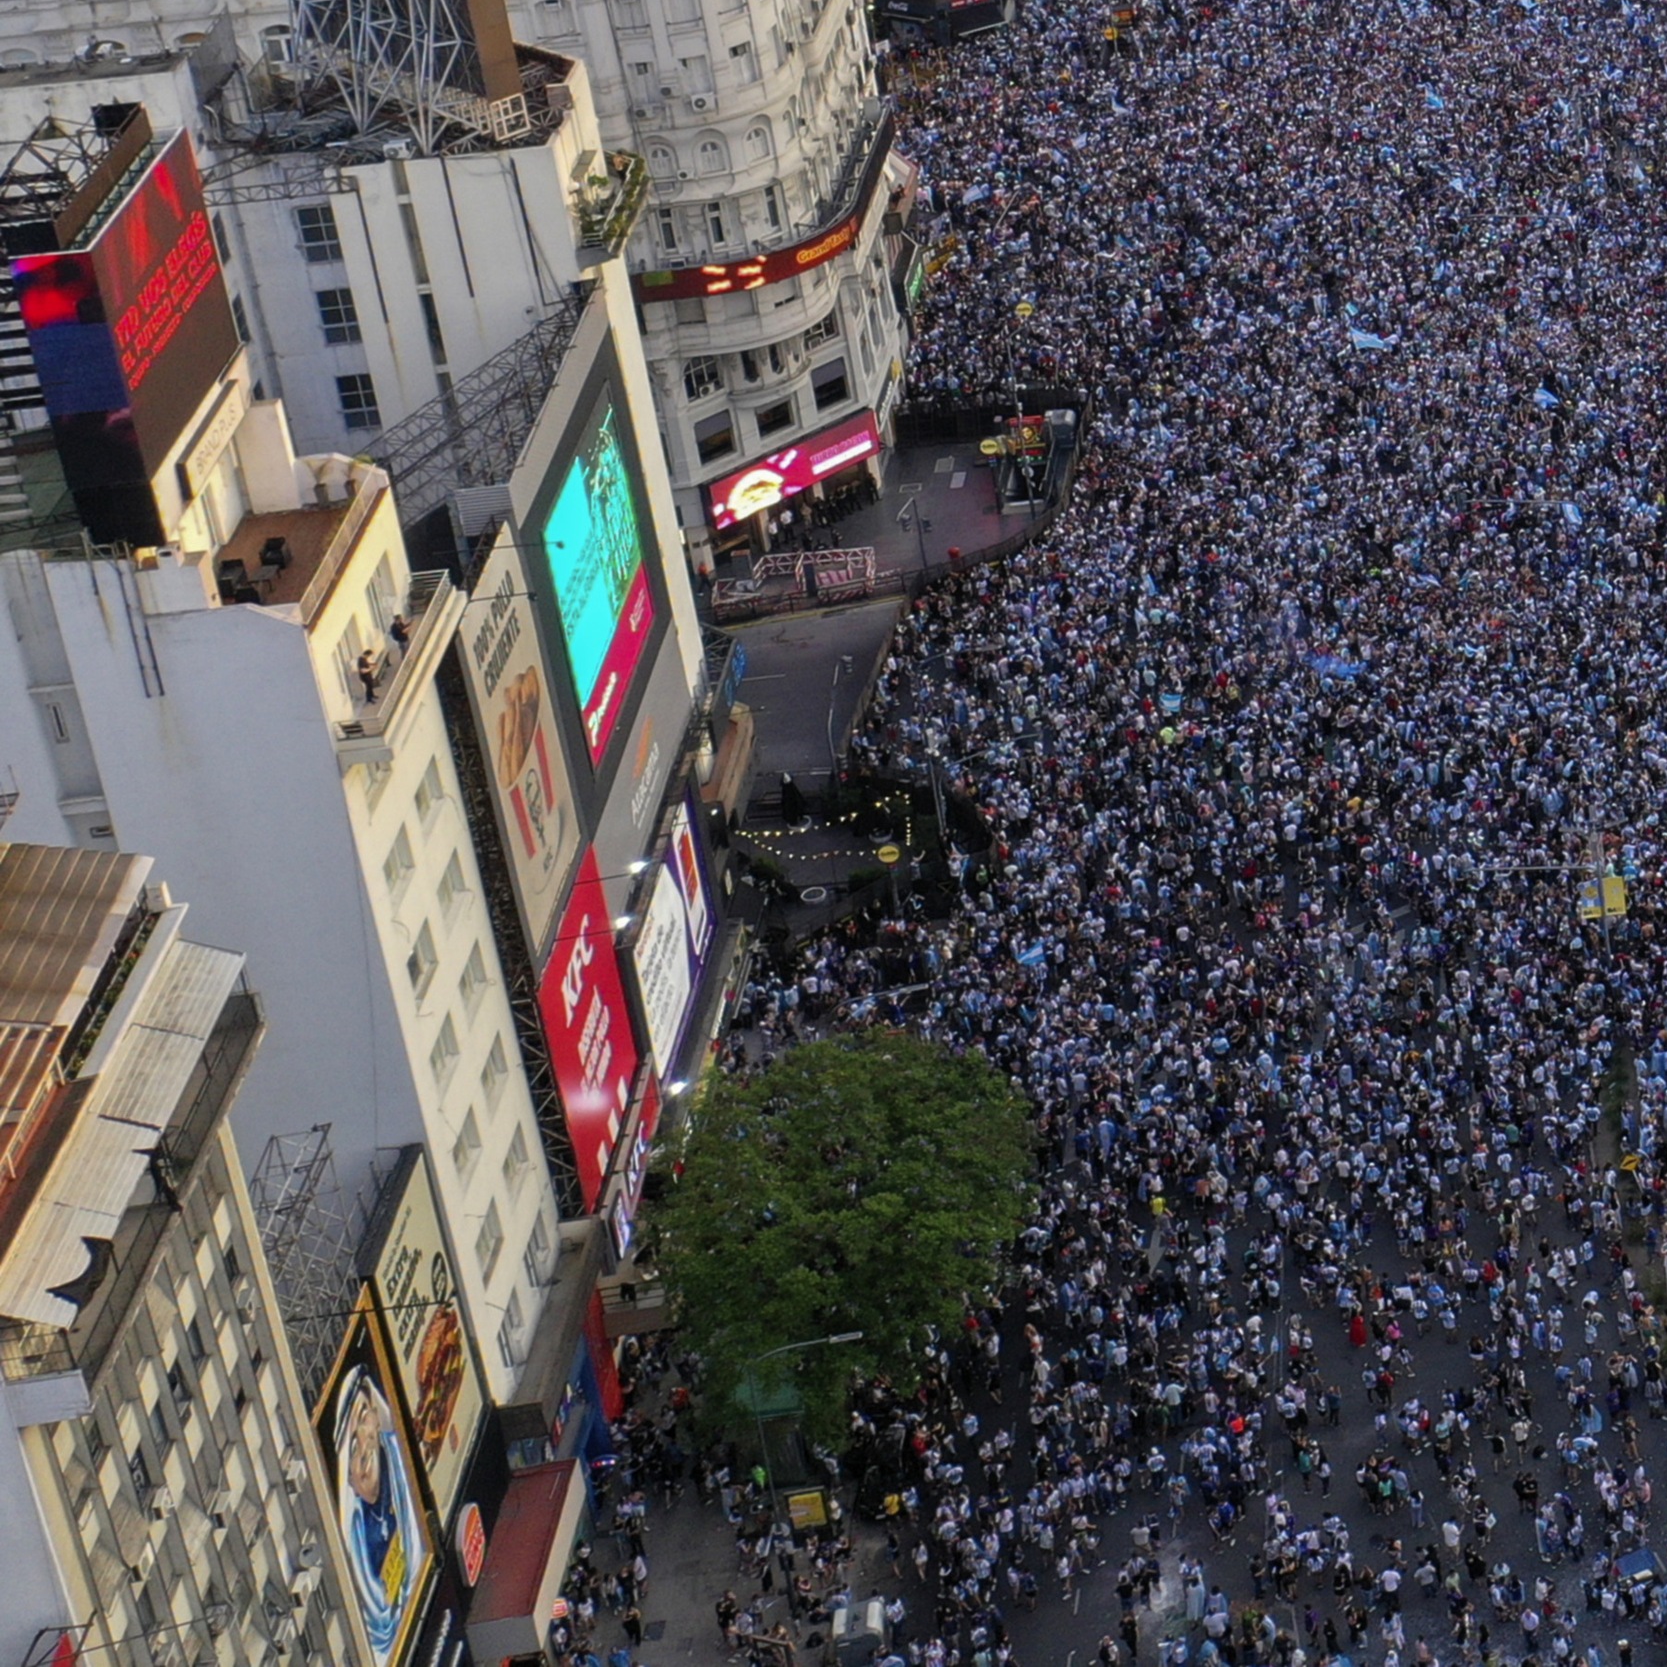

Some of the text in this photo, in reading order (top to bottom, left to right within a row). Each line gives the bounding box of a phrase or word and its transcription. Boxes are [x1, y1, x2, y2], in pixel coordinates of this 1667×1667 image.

[137, 266, 169, 314] VOS
[188, 238, 214, 280] CLUB
[473, 569, 514, 671] 100% POLLO
[484, 607, 521, 699] CRUJIENTE
[561, 913, 594, 1029] KFC
